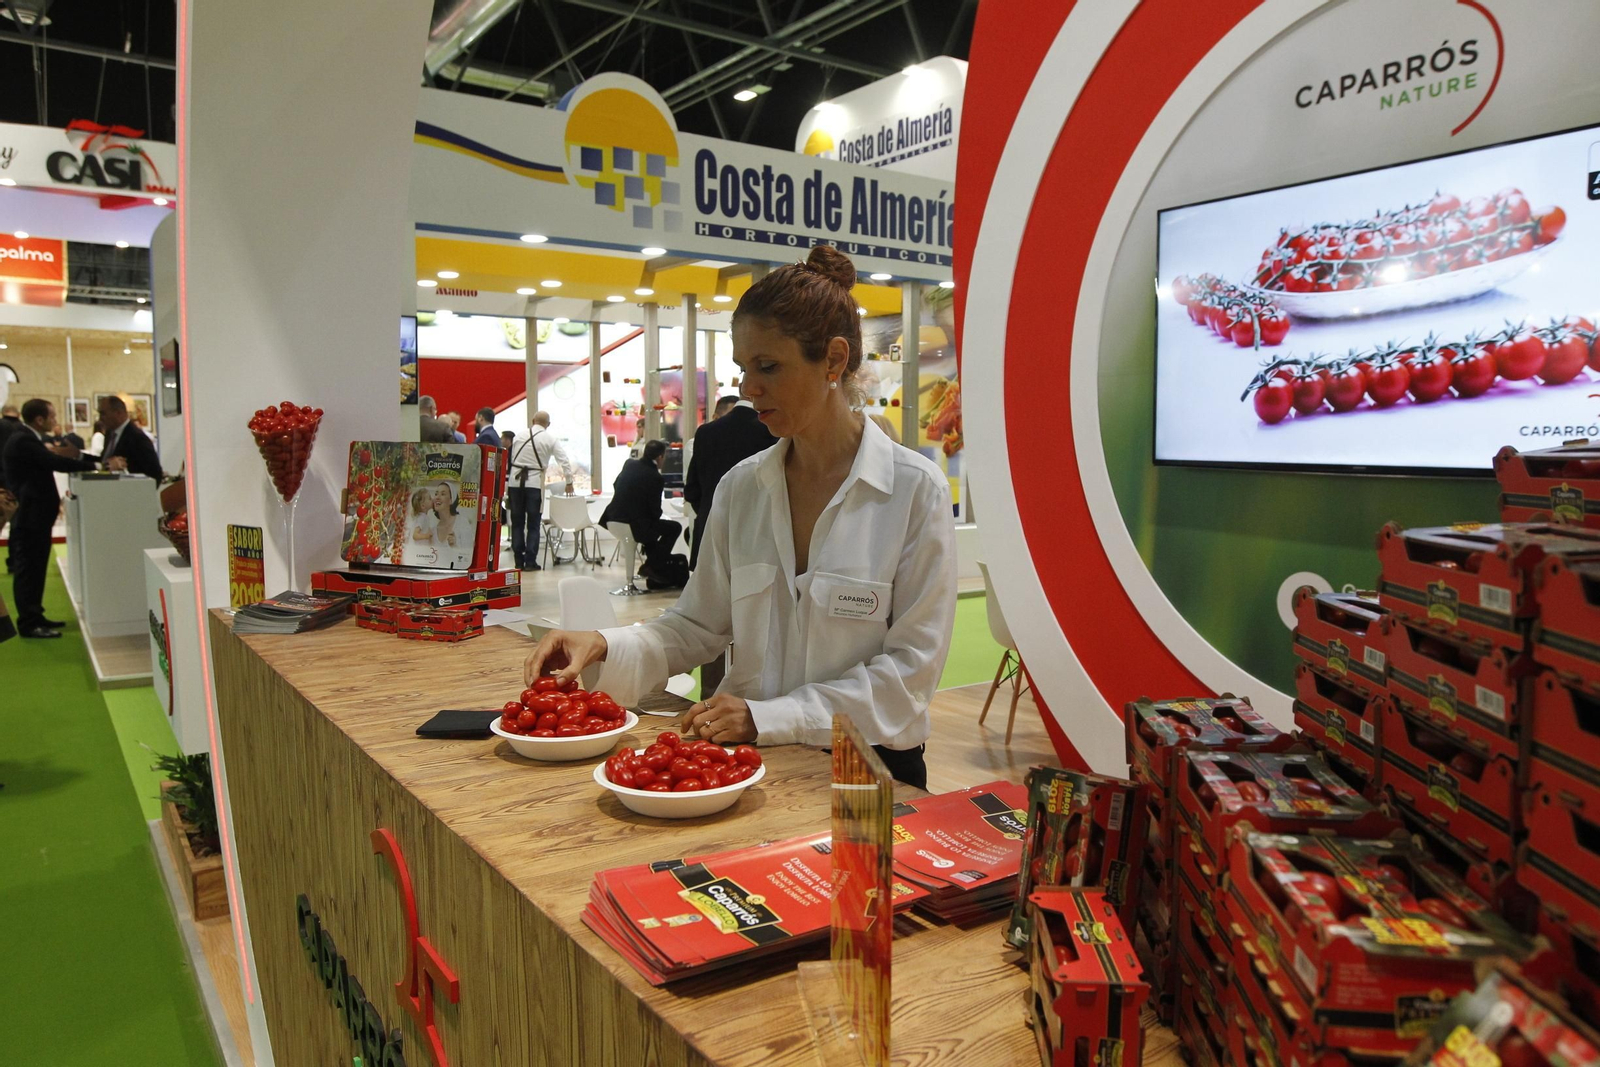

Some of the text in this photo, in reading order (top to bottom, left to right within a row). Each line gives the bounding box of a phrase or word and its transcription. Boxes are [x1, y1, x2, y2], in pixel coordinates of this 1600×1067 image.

[1295, 39, 1478, 108] CAPARRÓS
[1380, 73, 1478, 110] NATURE
[877, 125, 893, 157] de
[896, 103, 953, 151] Almería
[46, 151, 142, 191] CASI
[695, 148, 795, 226] Costa
[803, 168, 842, 232] de
[699, 223, 953, 265] HORTOFRUTICOL
[428, 460, 461, 470] Caparrós
[460, 499, 477, 508] 2019
[838, 594, 874, 604] CAPARRÓS
[1048, 779, 1059, 813] 2019
[892, 824, 916, 842] 2019
[697, 894, 735, 926] LOBELLO
[708, 885, 760, 926] Caparrós
